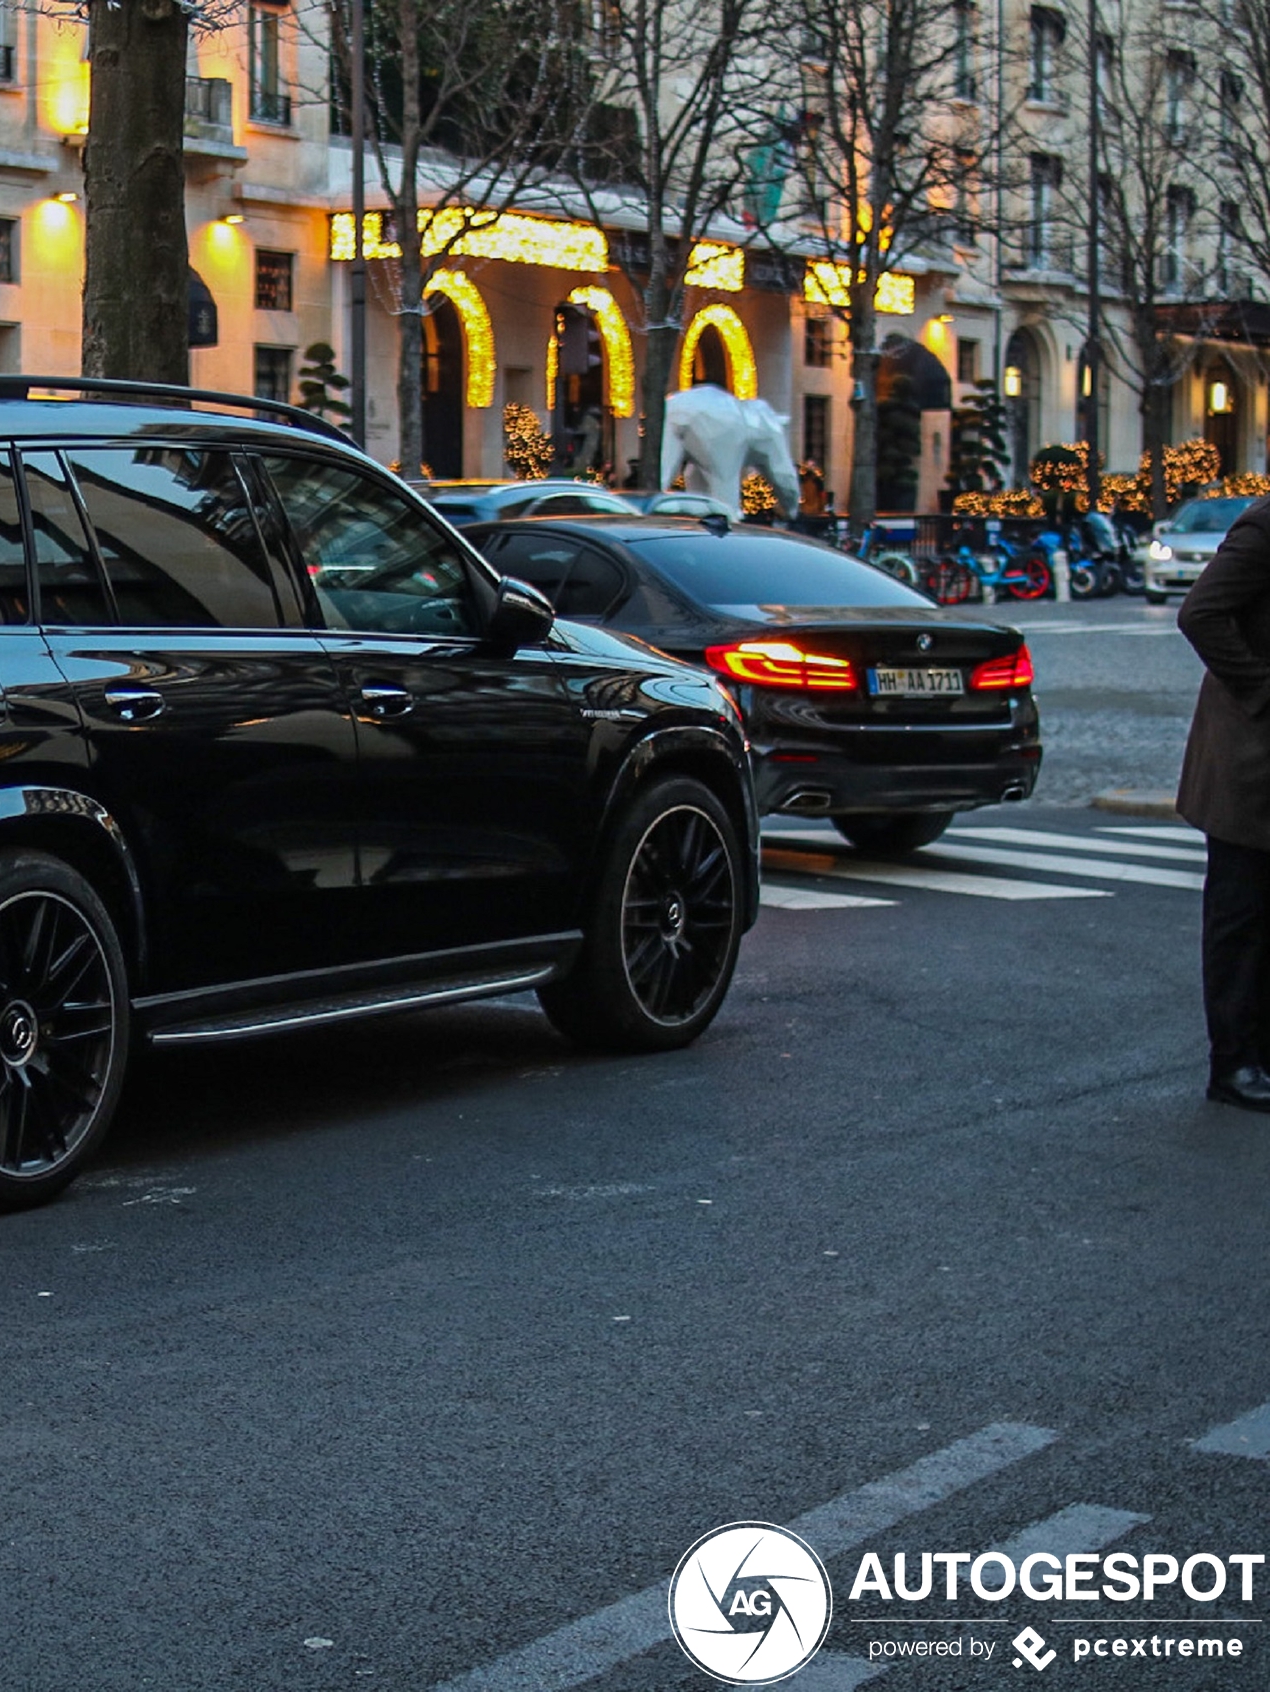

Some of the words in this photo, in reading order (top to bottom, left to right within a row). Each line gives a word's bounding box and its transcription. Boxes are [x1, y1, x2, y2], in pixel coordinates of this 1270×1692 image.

[877, 671, 897, 691] HH
[907, 672, 925, 691] AA
[928, 672, 961, 691] 1711
